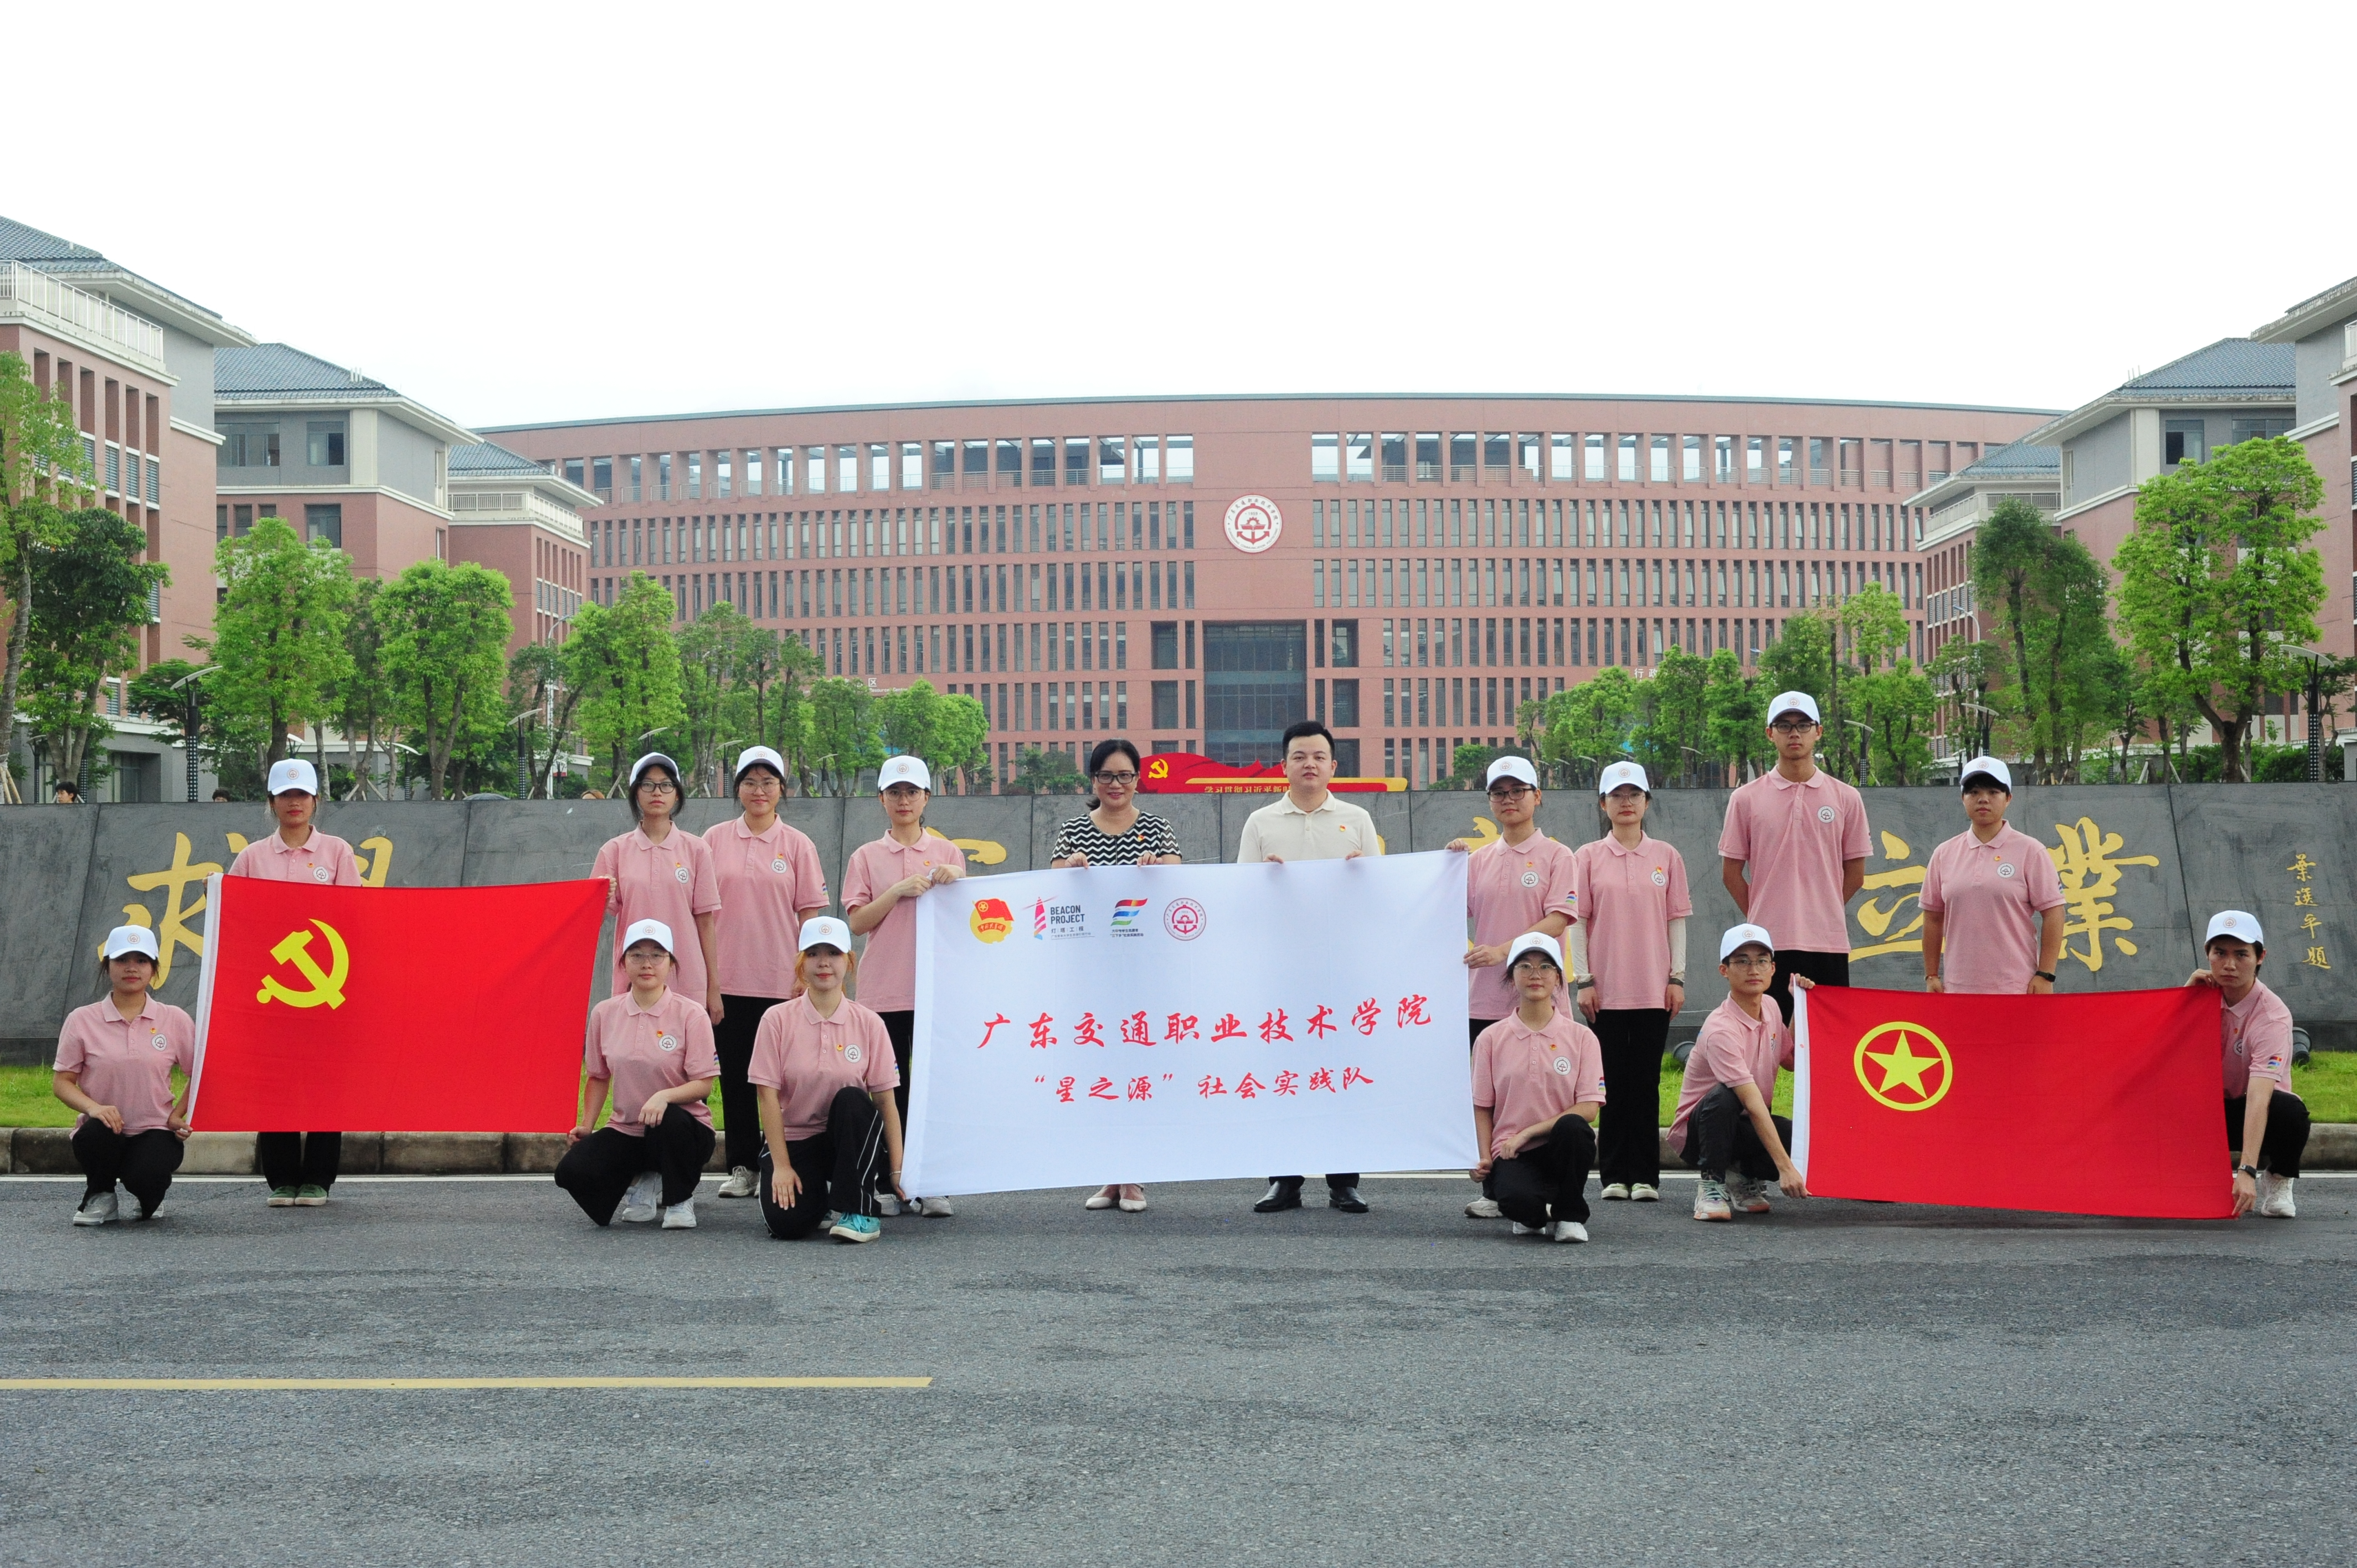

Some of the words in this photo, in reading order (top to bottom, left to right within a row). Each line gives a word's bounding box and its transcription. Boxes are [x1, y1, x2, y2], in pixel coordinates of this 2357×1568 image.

[1050, 905, 1081, 915] BEACON
[1051, 914, 1085, 924] PROJECT
[977, 994, 1431, 1049] 广东交通职业技术学院
